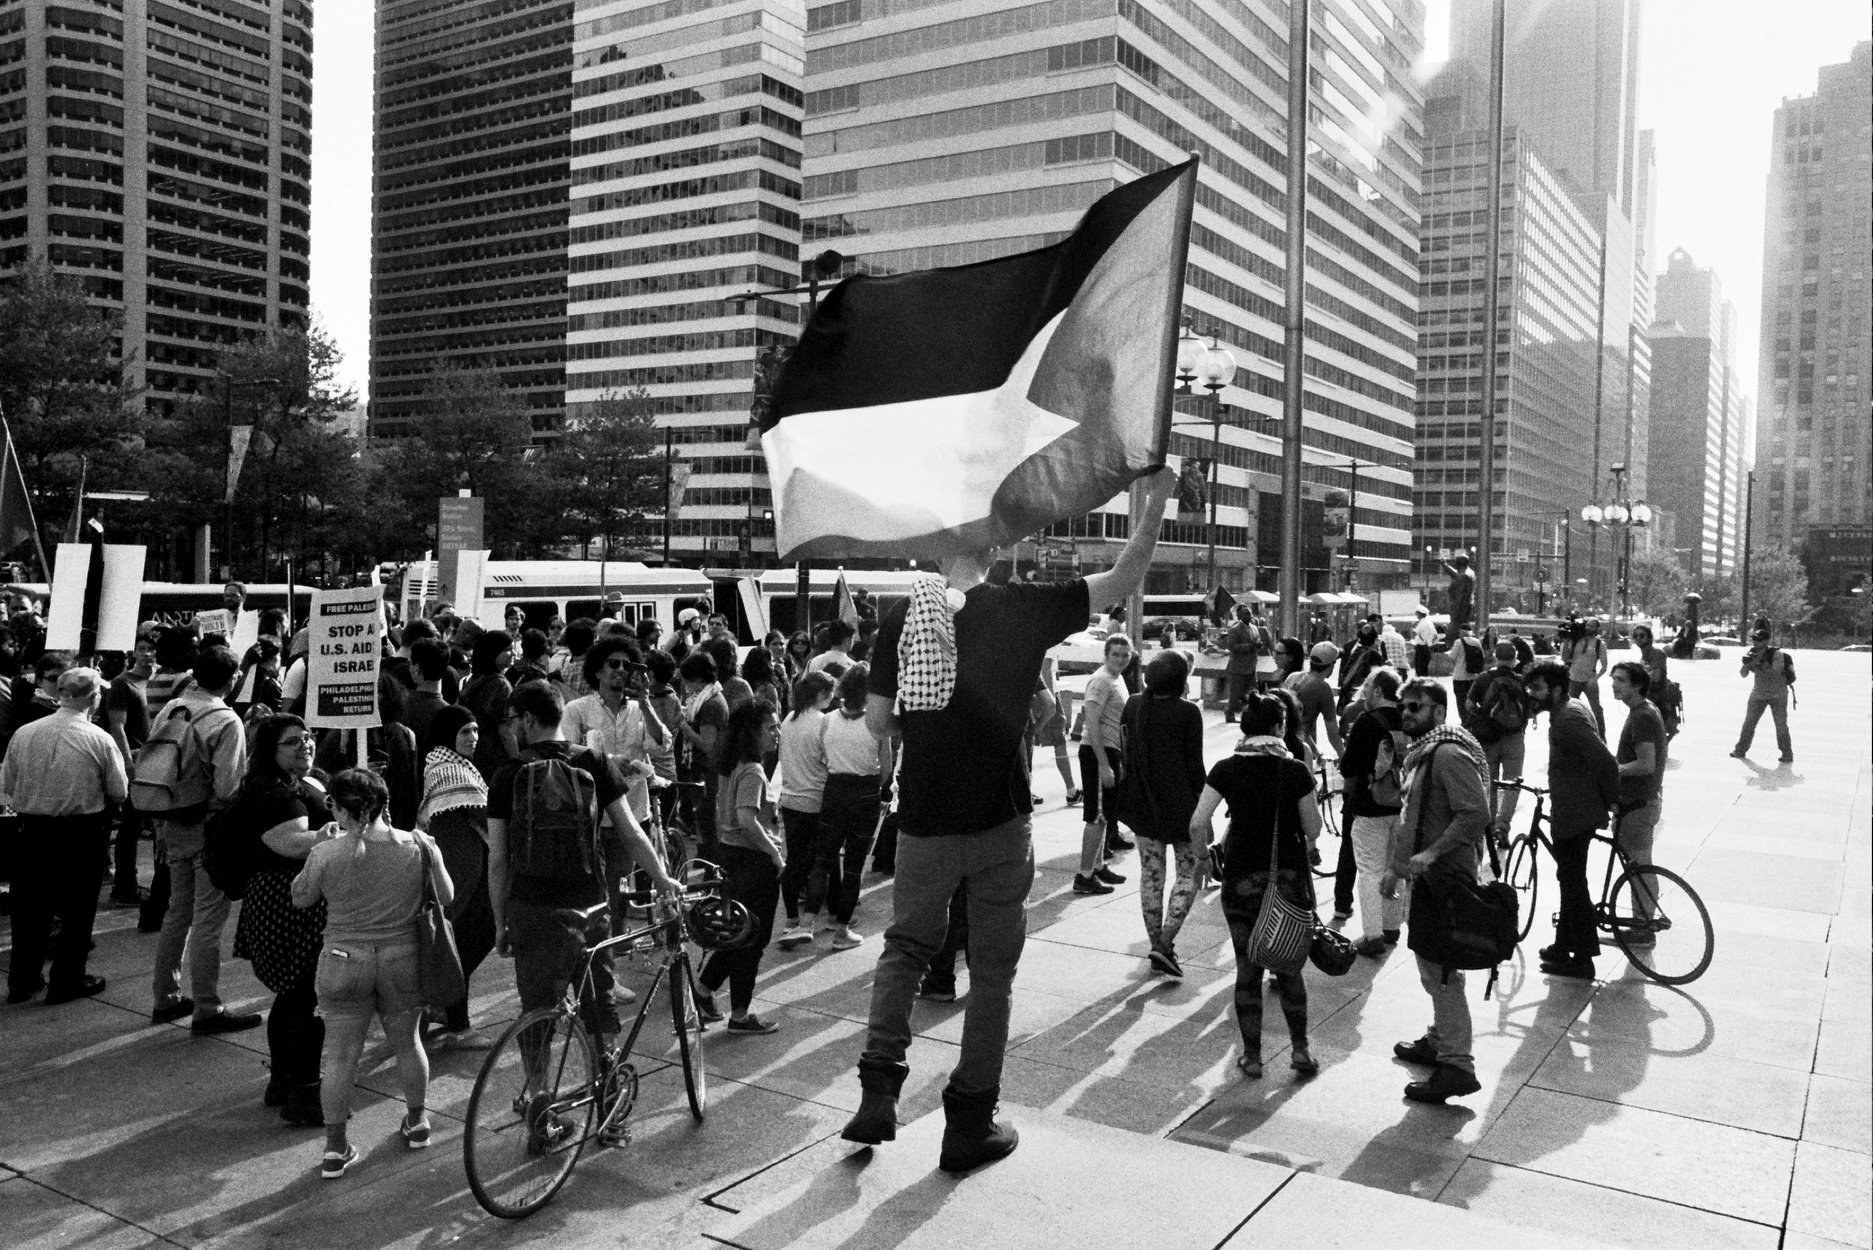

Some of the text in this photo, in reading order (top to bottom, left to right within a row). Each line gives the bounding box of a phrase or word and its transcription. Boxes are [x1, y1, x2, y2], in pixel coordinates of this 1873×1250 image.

[326, 605, 347, 614] FREE
[328, 625, 364, 637] STOP
[320, 642, 373, 656] U.S. AID
[343, 705, 372, 714] RETURN
